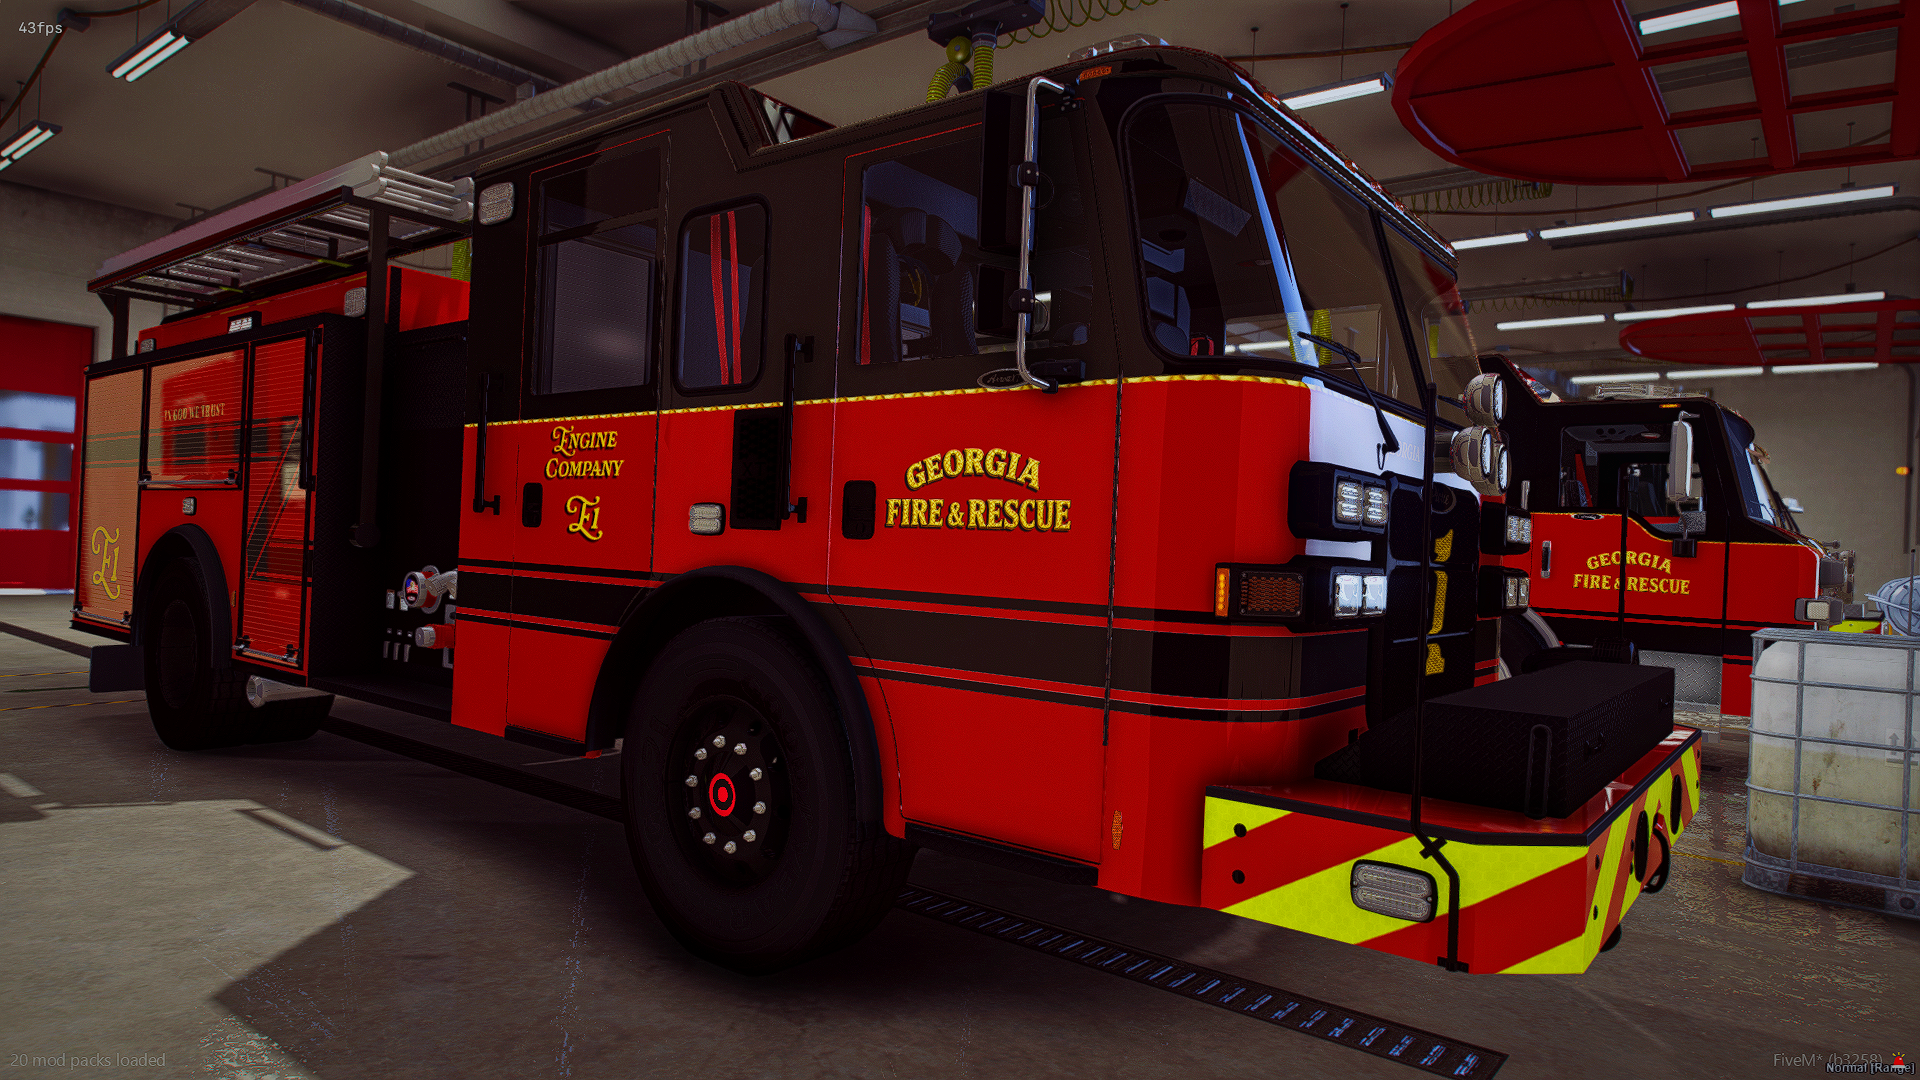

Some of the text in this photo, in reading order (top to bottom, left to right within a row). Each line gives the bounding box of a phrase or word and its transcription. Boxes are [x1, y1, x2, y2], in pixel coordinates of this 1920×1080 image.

[201, 402, 226, 418] TRUST
[905, 448, 1041, 492] GEORGIA
[885, 498, 1072, 533] FIRE & RESCUE
[1586, 550, 1672, 575] GEORGIA
[1572, 573, 1612, 591] FIRE
[1626, 576, 1690, 596] RESCUE
